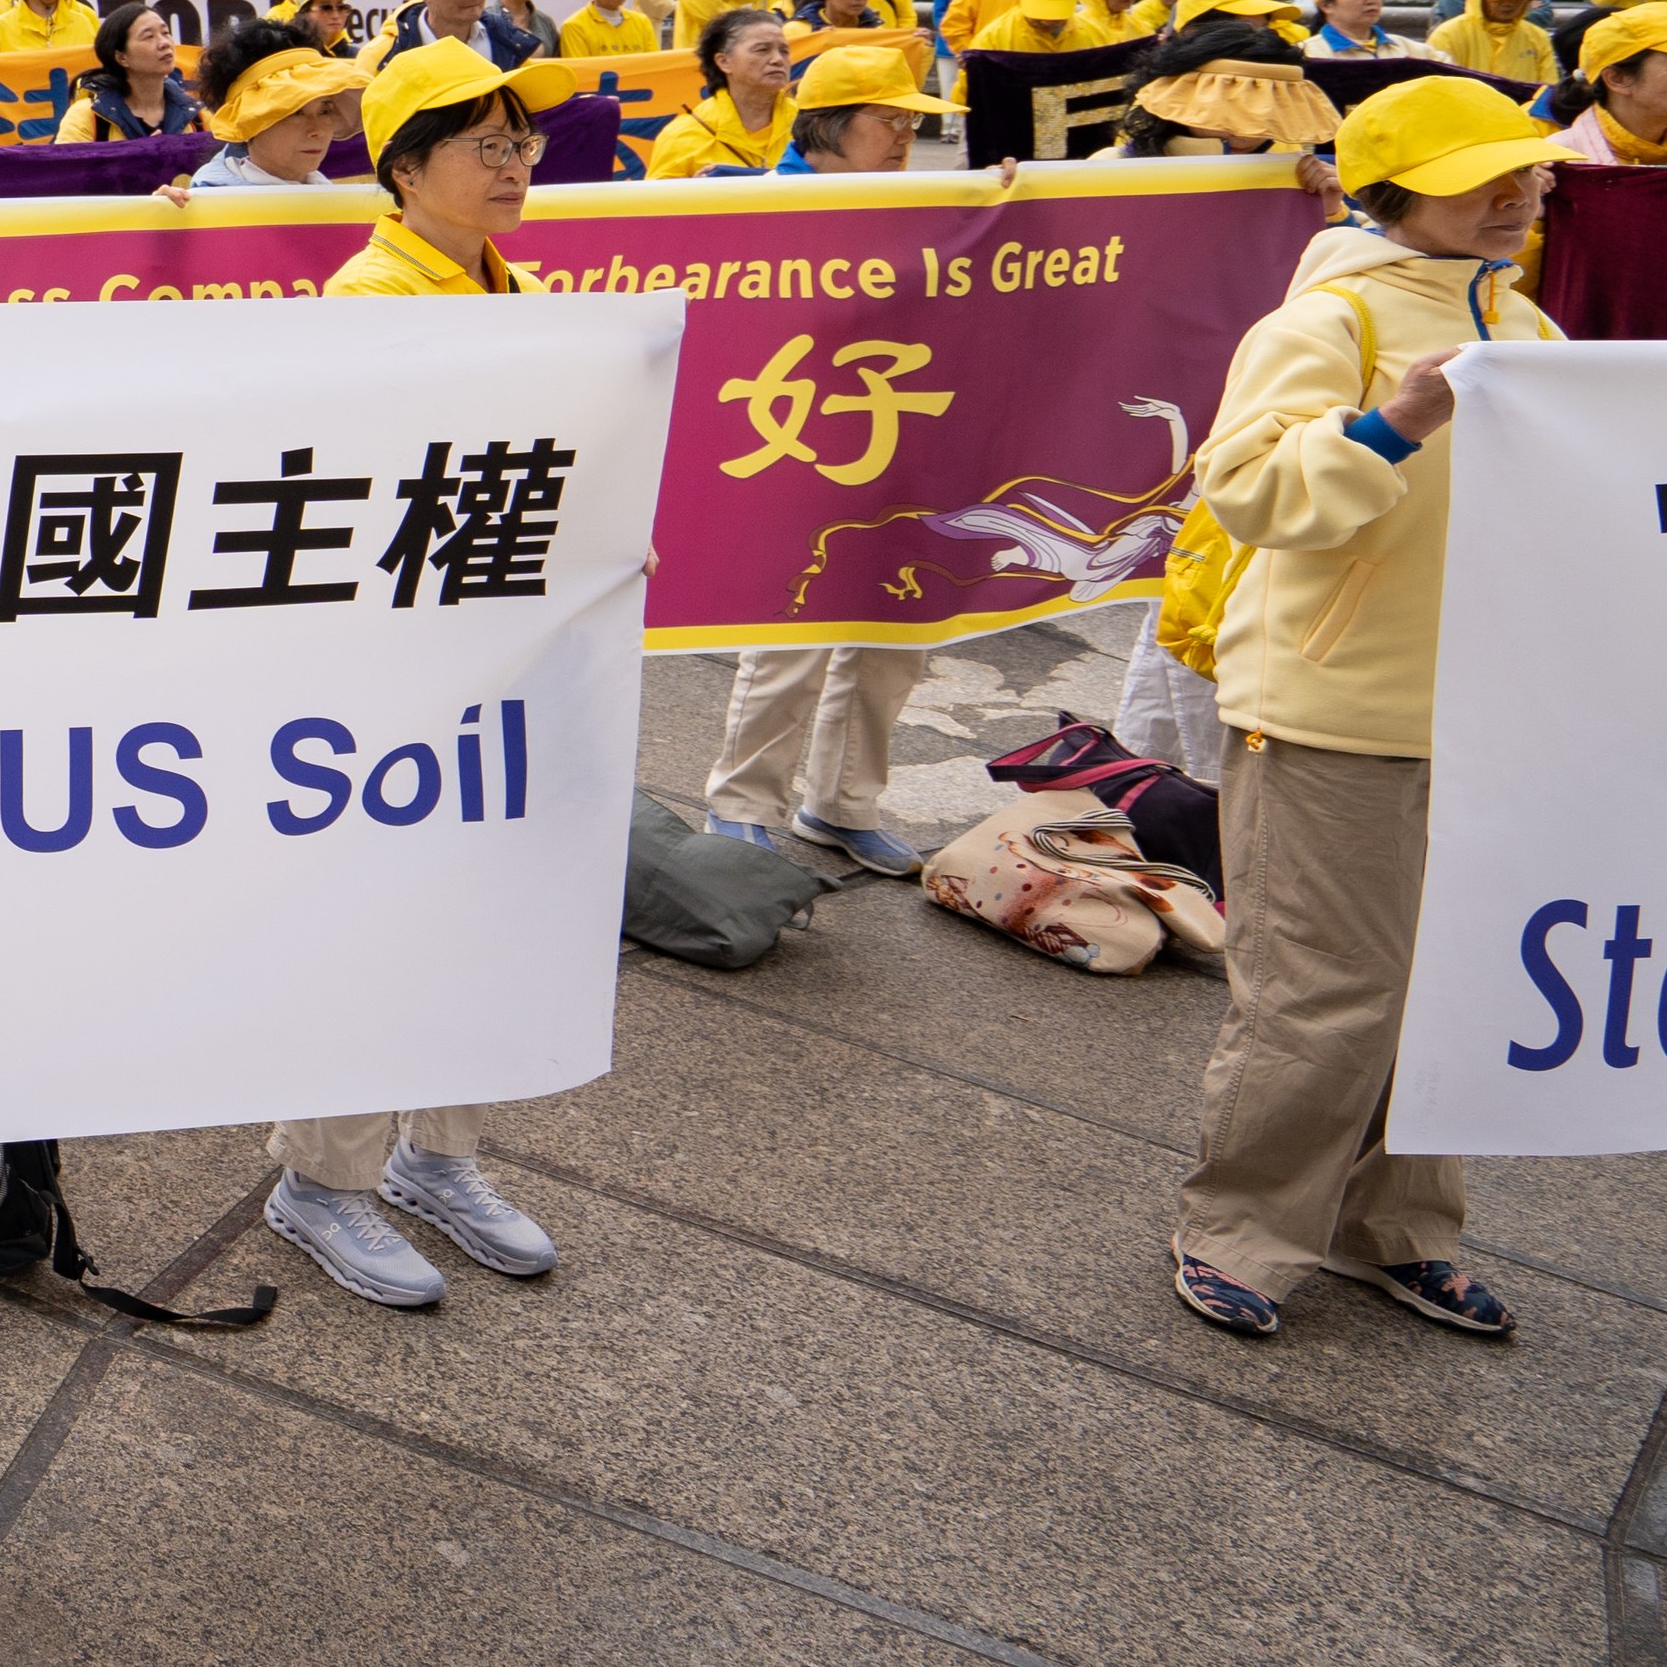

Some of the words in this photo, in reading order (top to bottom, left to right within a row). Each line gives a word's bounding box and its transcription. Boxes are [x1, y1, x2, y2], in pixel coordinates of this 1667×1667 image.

[922, 247, 973, 297] Is
[991, 235, 1125, 294] Great
[717, 333, 956, 487] 好
[265, 699, 530, 836] Soil
[1505, 897, 1667, 1072] St
